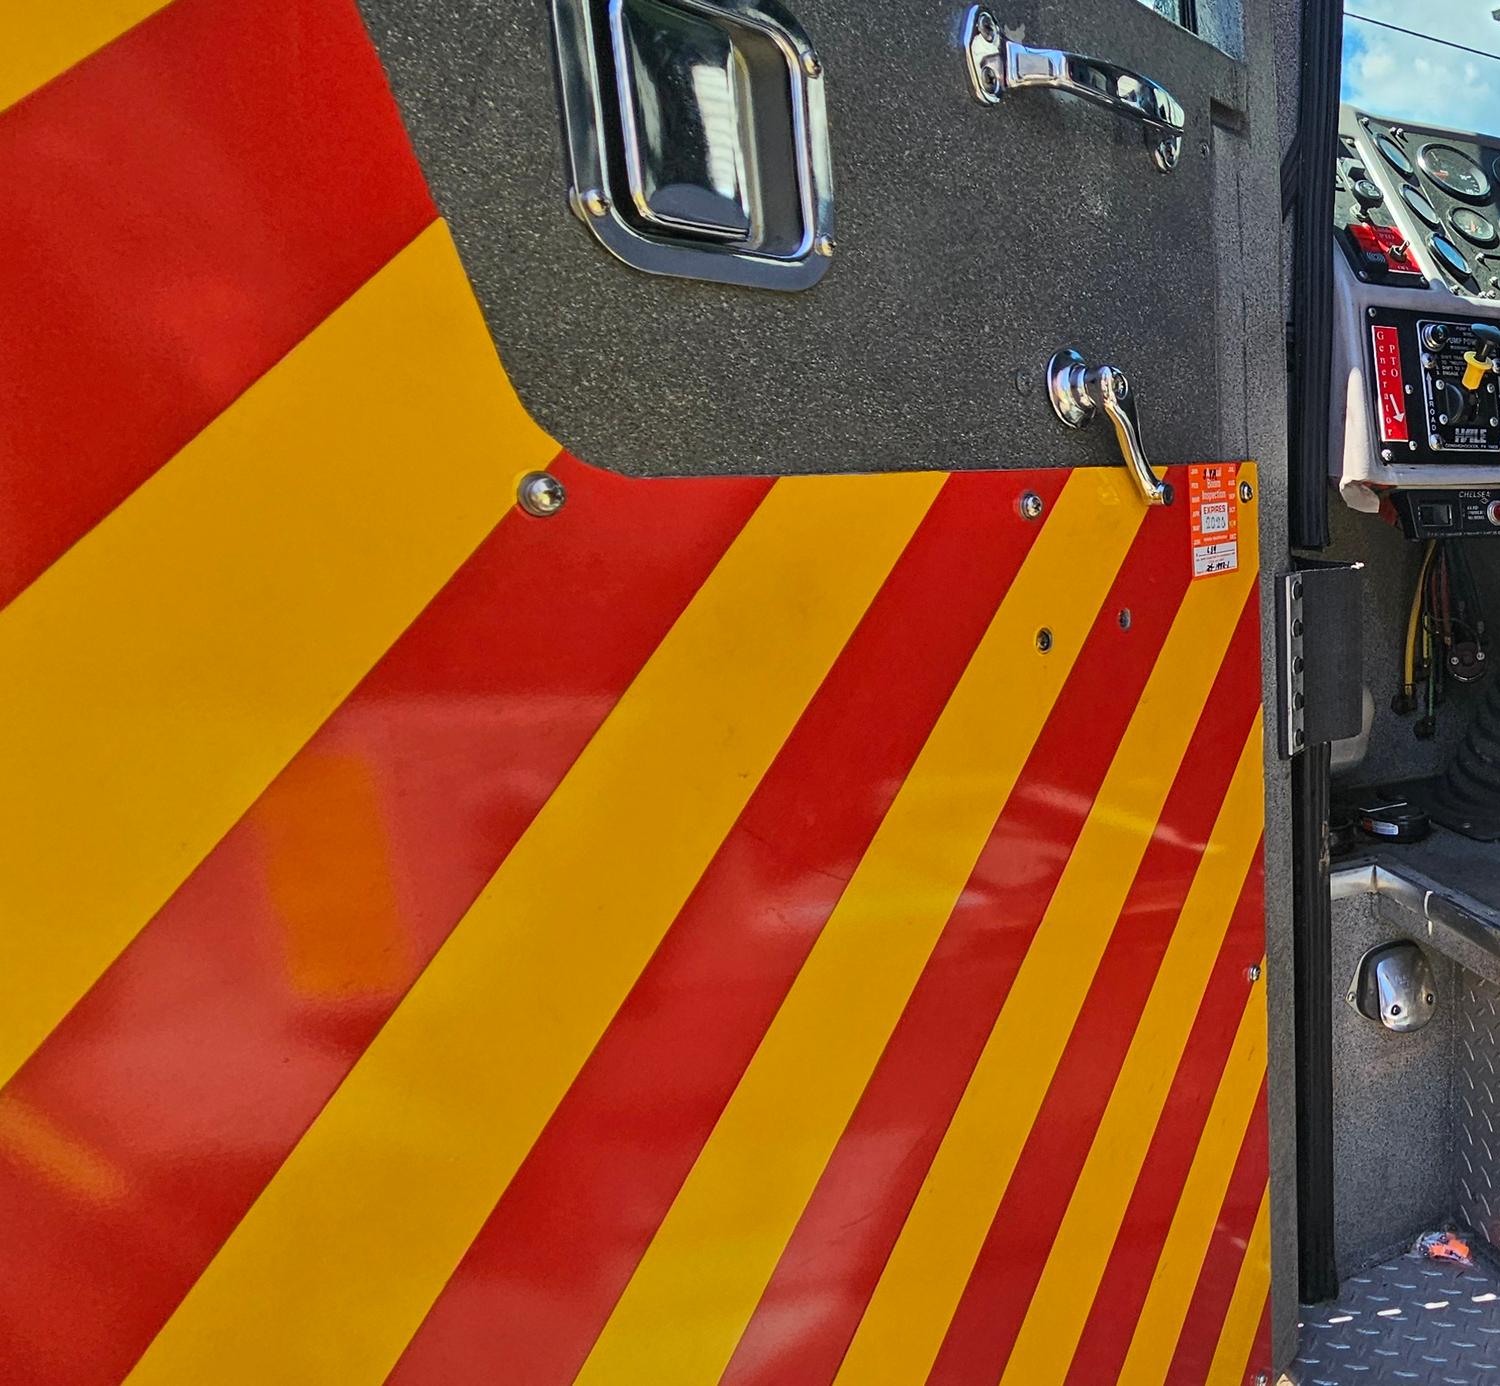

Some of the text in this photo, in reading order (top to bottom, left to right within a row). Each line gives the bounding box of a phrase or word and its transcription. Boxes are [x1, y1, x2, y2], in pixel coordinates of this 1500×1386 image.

[1389, 344, 1399, 377] PTO
[1377, 331, 1393, 436] Generator
[1429, 401, 1437, 431] ROAD
[1455, 428, 1487, 443] HALE
[1203, 504, 1226, 514] EXPIRES
